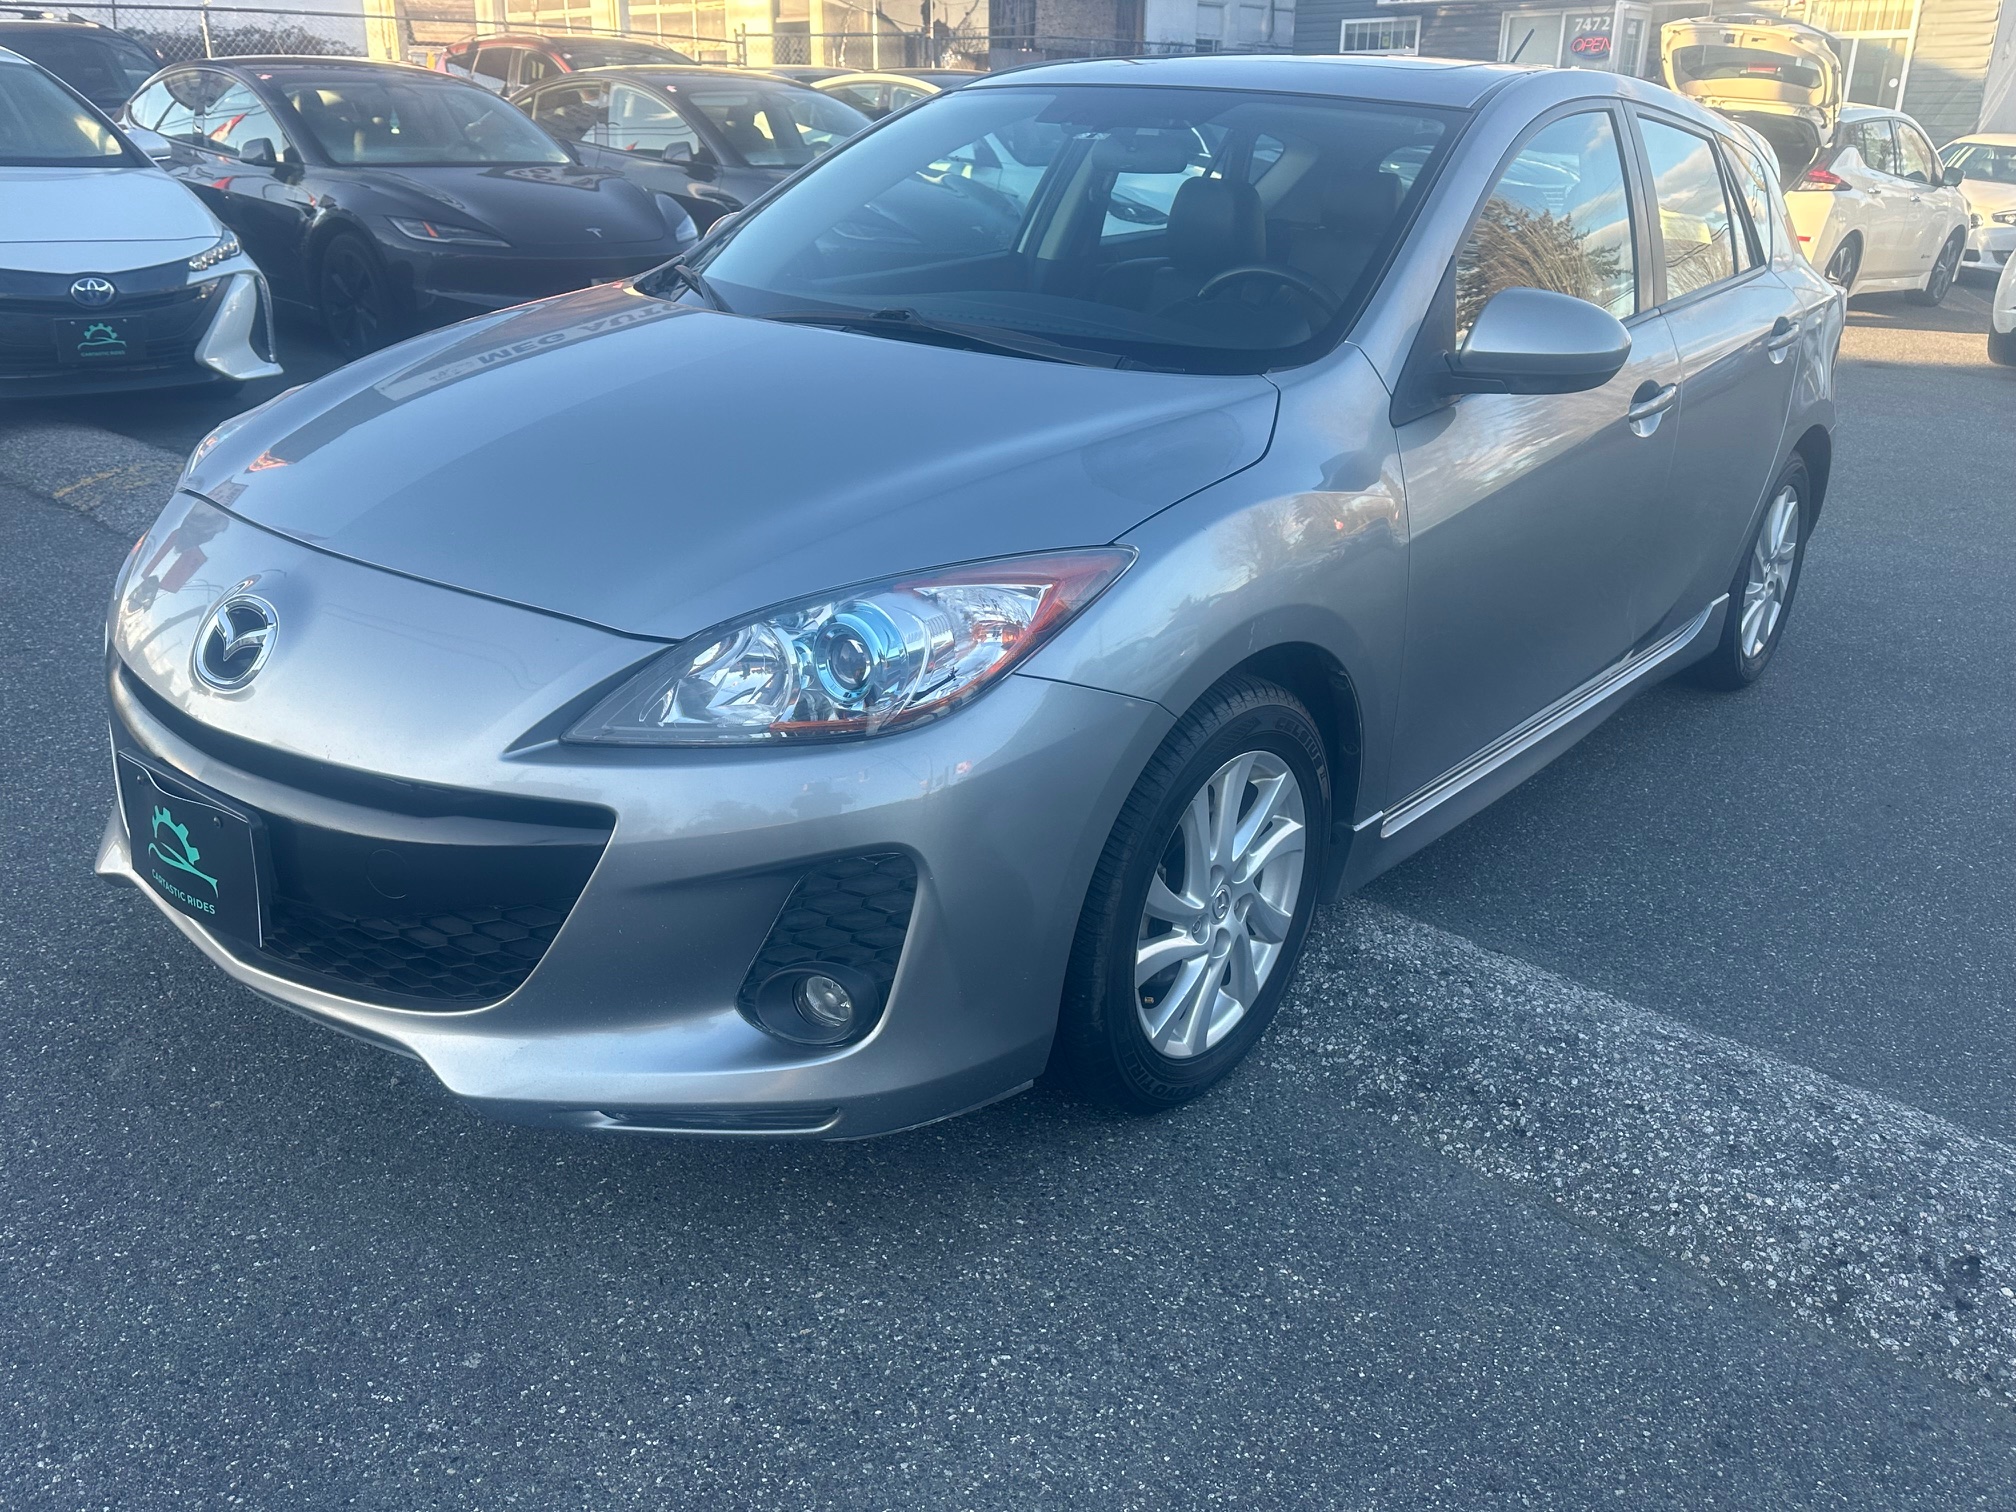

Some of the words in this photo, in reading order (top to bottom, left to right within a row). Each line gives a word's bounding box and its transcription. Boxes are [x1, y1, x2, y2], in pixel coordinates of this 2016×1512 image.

[1575, 16, 1611, 32] 7472
[1571, 36, 1611, 53] OPEN
[1275, 716, 1323, 769] CELSIUS
[151, 868, 186, 902] CARTASTIC
[187, 893, 216, 915] RIDES
